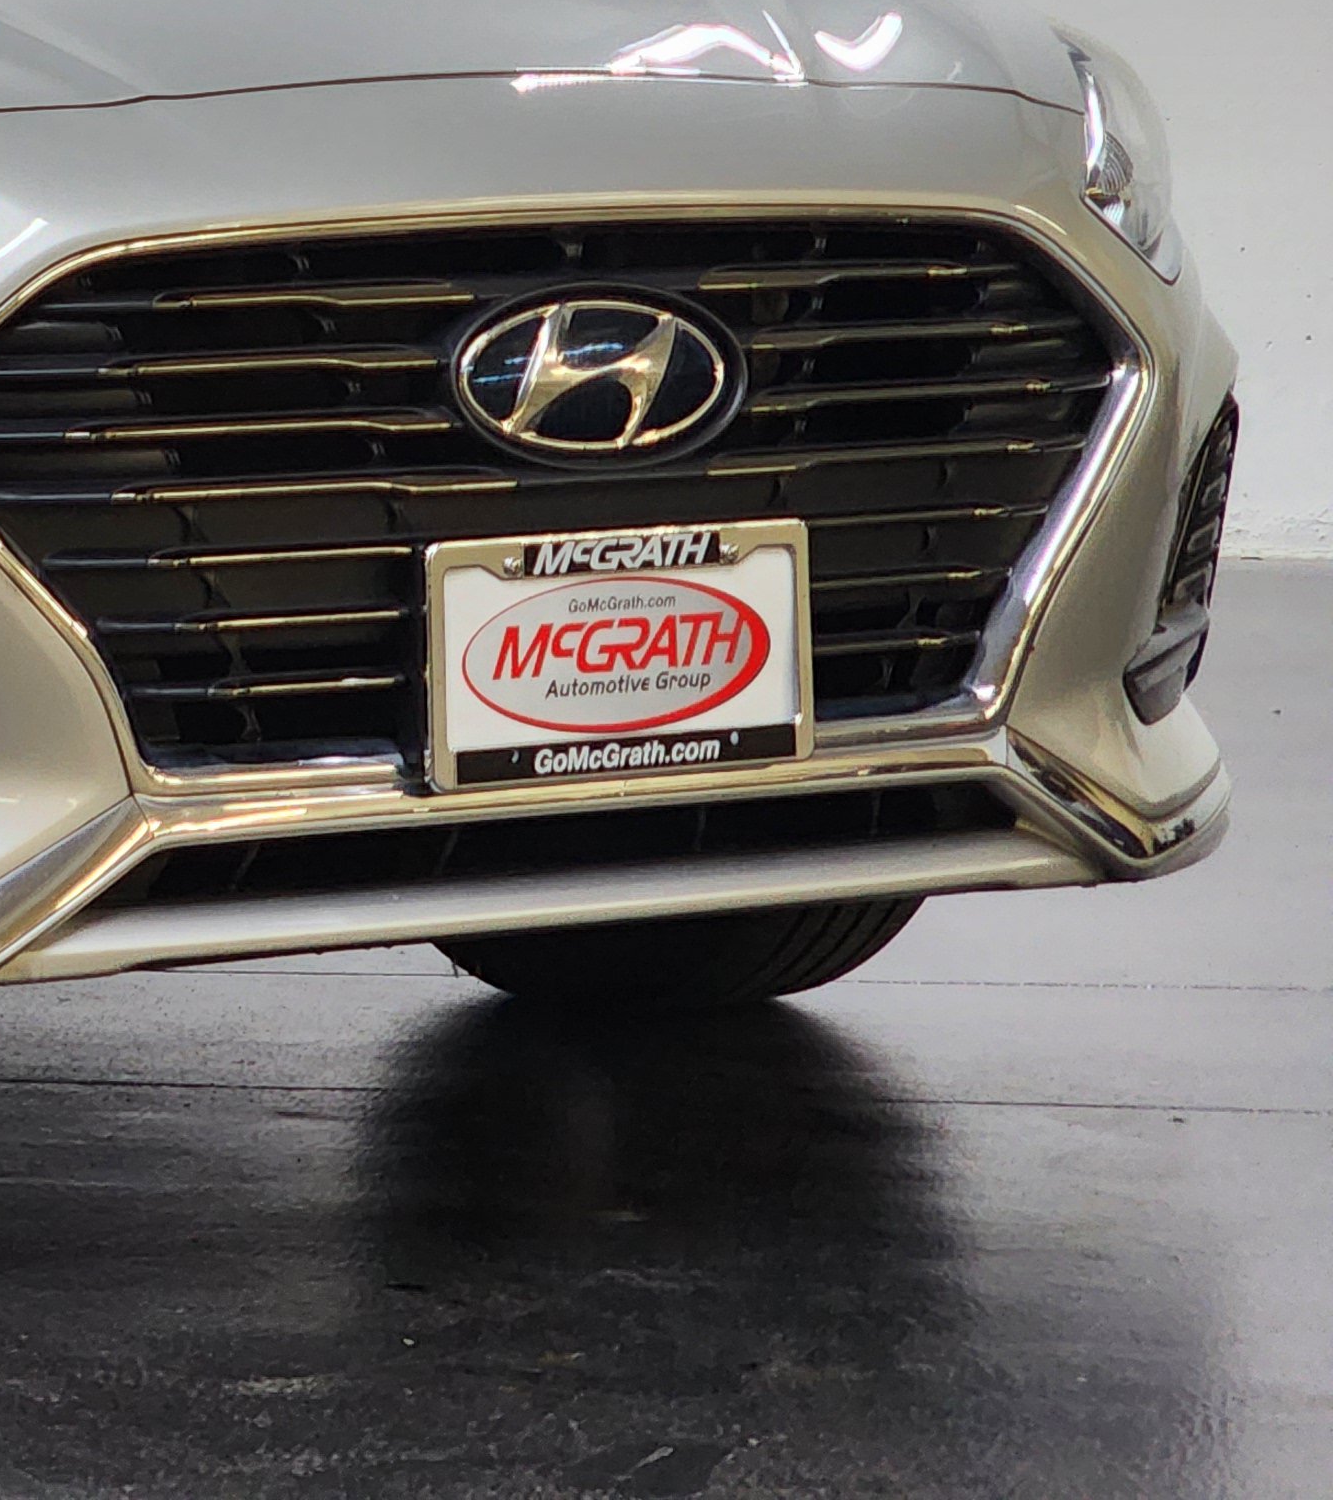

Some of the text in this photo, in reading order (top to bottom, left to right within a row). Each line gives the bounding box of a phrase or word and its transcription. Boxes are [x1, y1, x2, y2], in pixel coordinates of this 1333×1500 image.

[568, 595, 676, 613] GoMcGrath.com
[545, 670, 711, 700] Automotive Group
[534, 738, 721, 776] GoMcGrath.com
